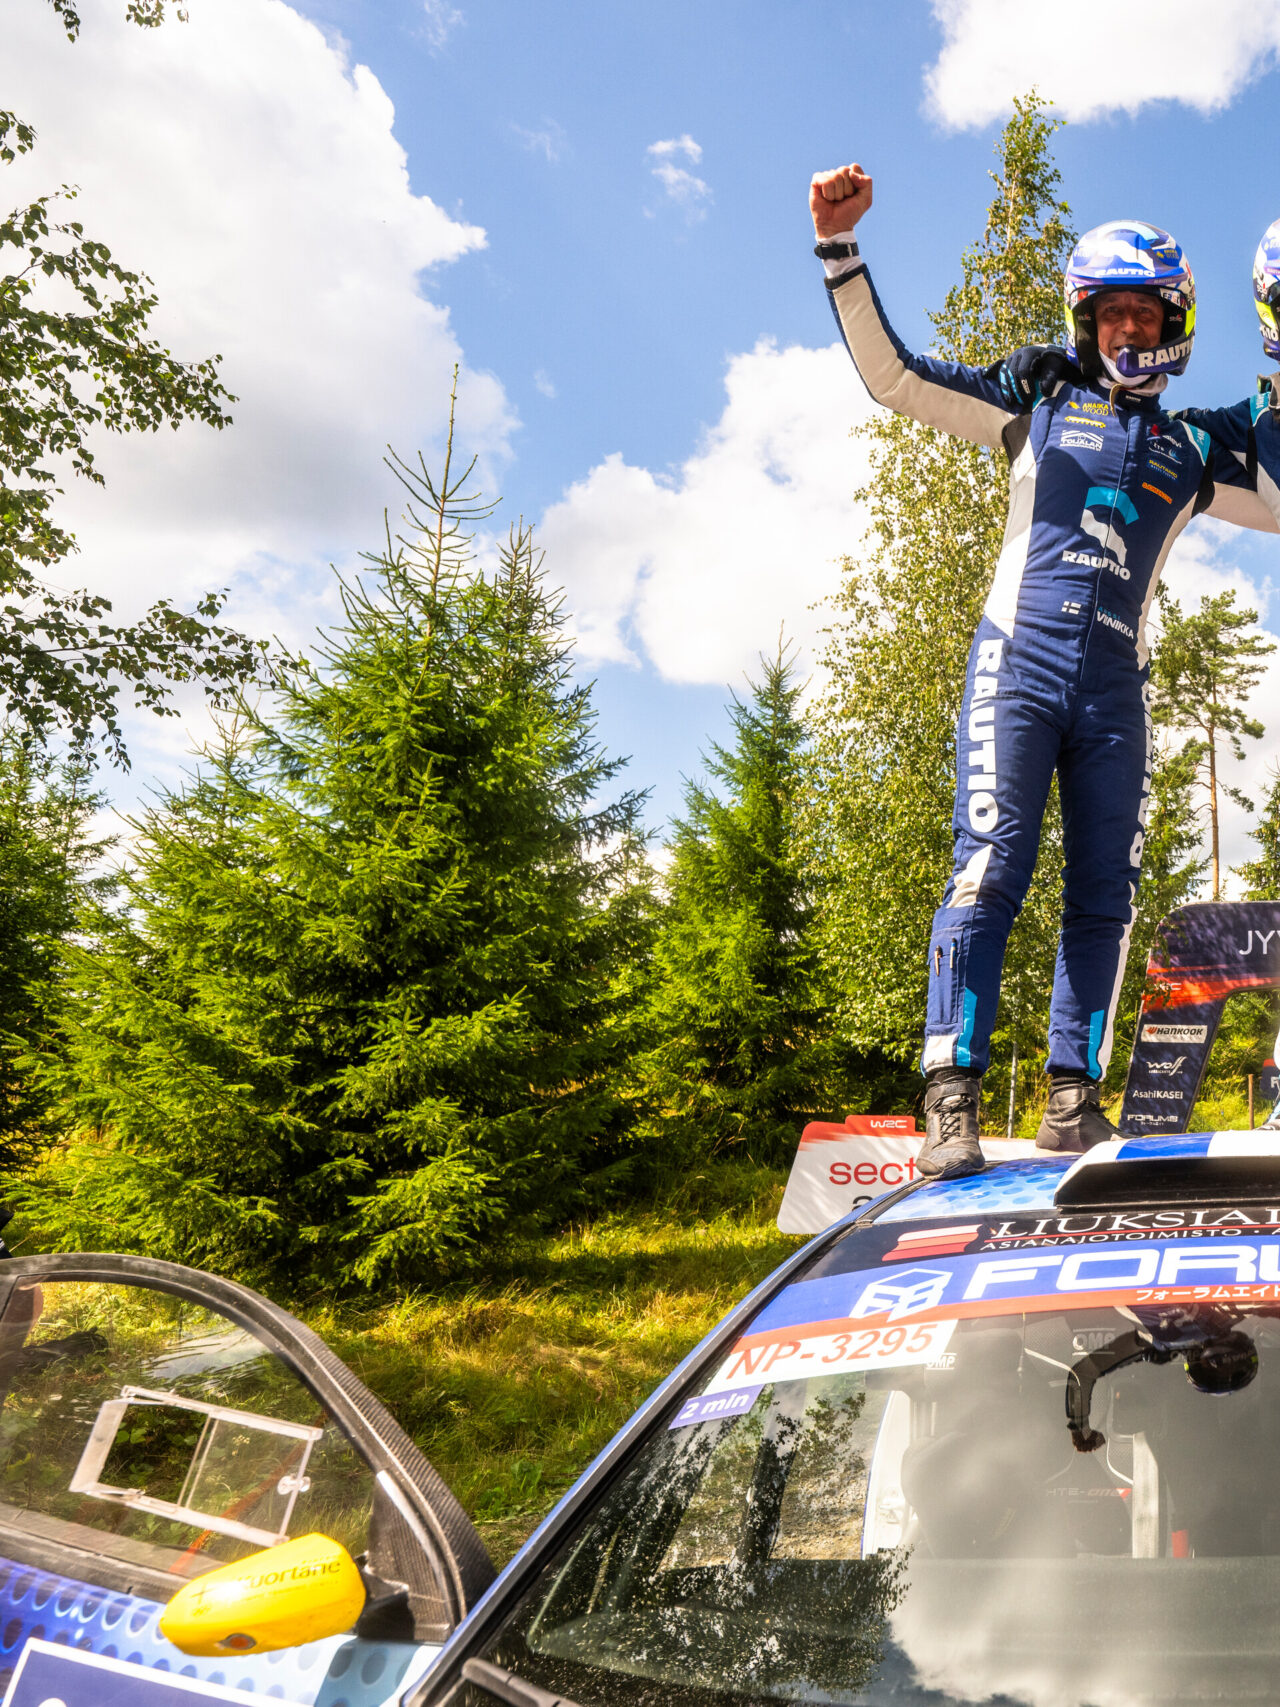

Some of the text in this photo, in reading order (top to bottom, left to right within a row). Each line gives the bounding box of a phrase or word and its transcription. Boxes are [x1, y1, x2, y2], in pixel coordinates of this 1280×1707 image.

[1061, 550, 1131, 581] RAUTIO
[967, 638, 1003, 833] RAUTIO
[828, 1157, 922, 1186] sect
[980, 1228, 1242, 1251] ASIANAJOTOIMISTO
[726, 1323, 938, 1380] NP-3295
[679, 1391, 751, 1420] 2 min
